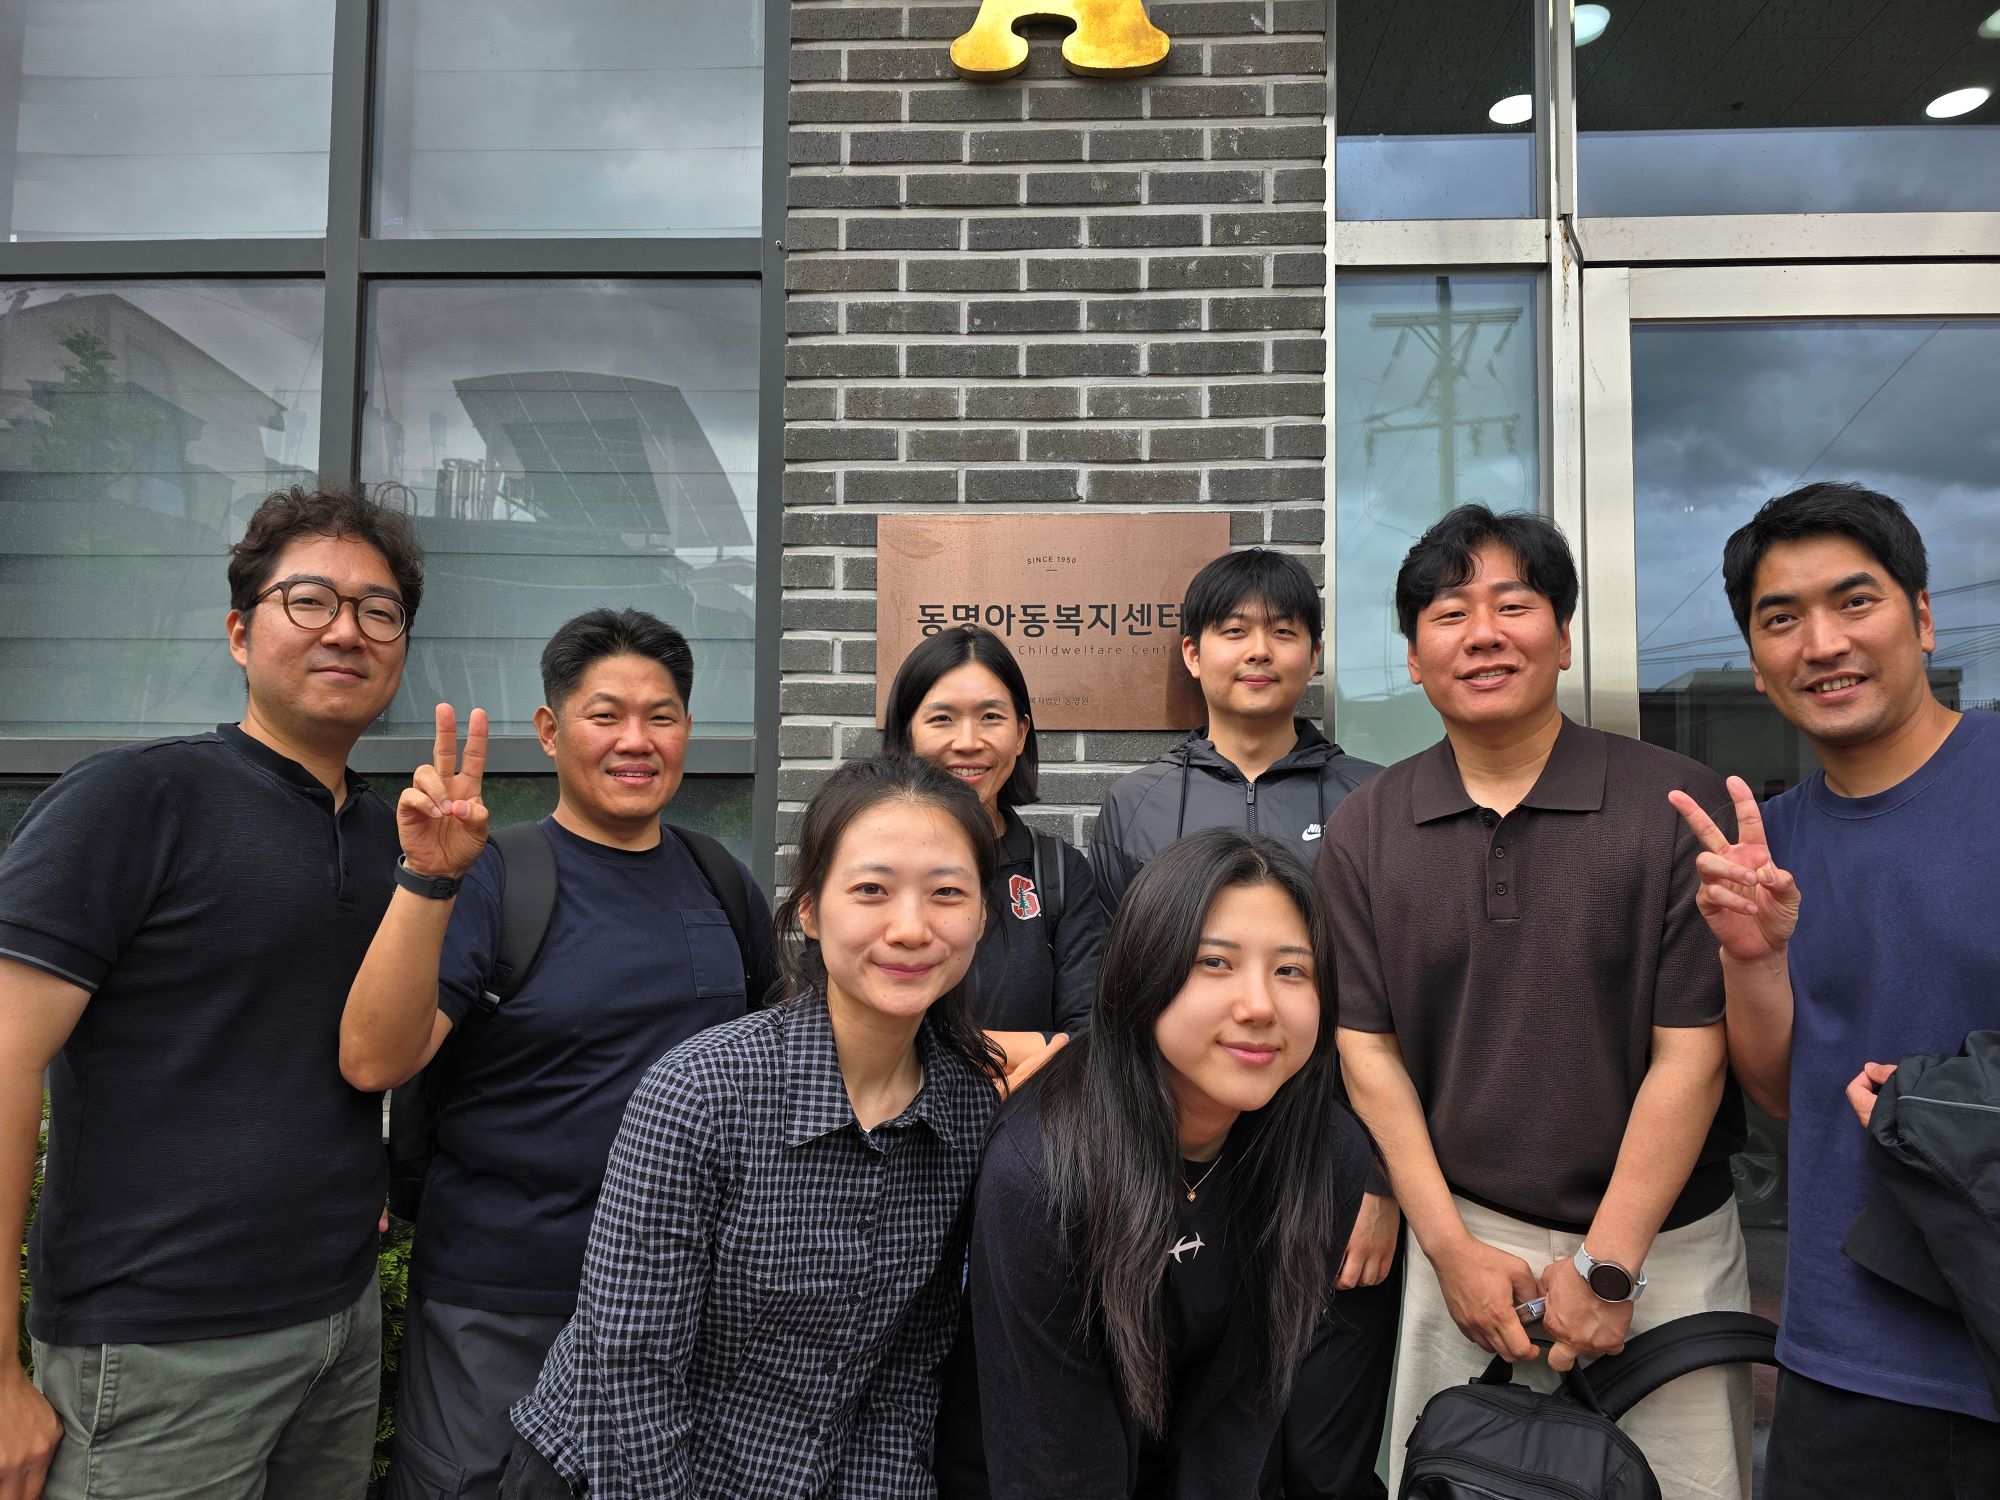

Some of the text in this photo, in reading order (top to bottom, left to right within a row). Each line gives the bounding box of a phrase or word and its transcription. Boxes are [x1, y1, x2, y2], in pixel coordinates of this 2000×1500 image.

[1026, 556, 1077, 565] SINCE 1950
[916, 603, 1187, 638] 동명아동복지센터
[1018, 644, 1176, 655] Childwelfare Cente
[1029, 696, 1061, 706] 복지법인
